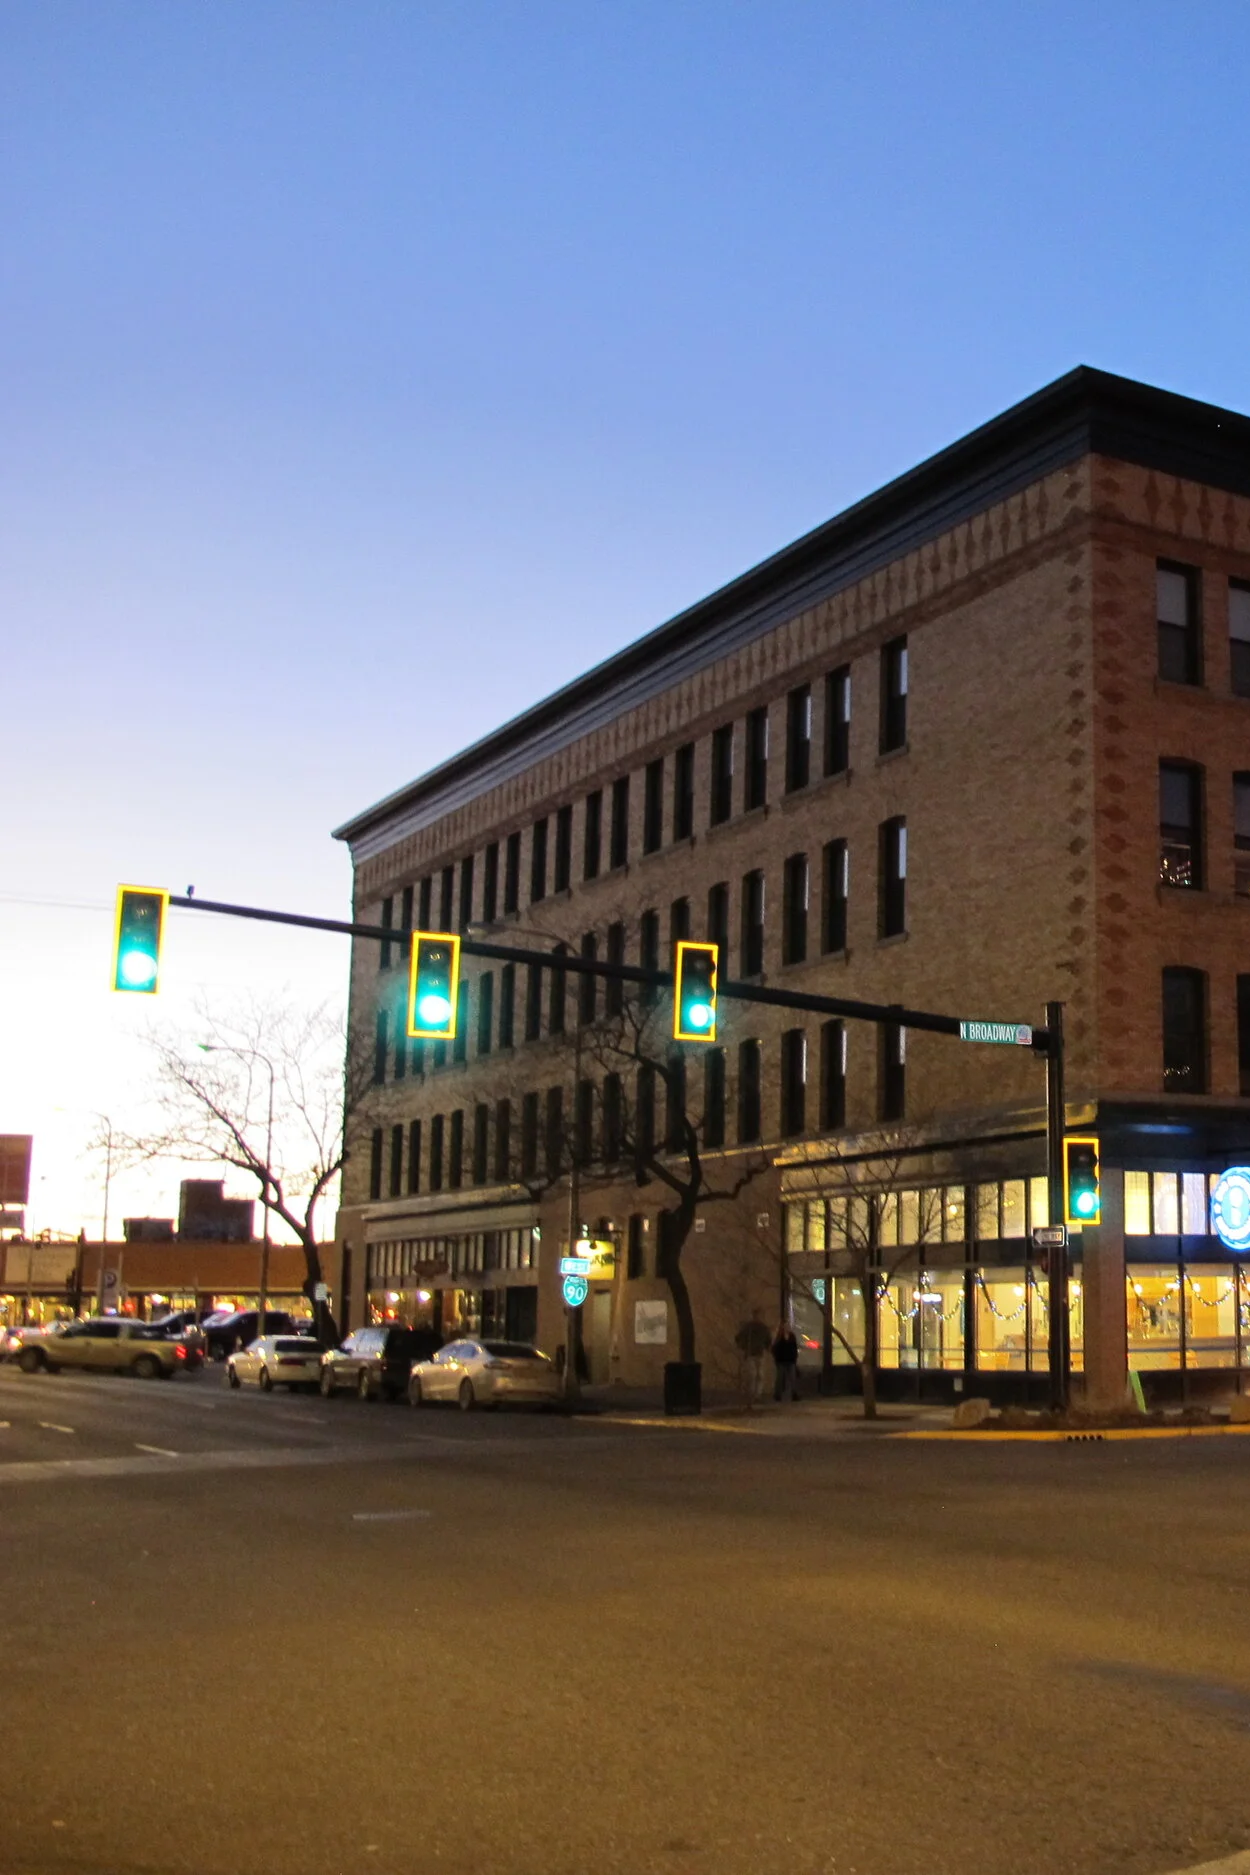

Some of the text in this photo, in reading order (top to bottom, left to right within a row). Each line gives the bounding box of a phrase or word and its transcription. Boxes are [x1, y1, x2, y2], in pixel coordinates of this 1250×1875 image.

[960, 1022, 1016, 1041] N BROADWAY
[566, 1285, 584, 1301] 90
